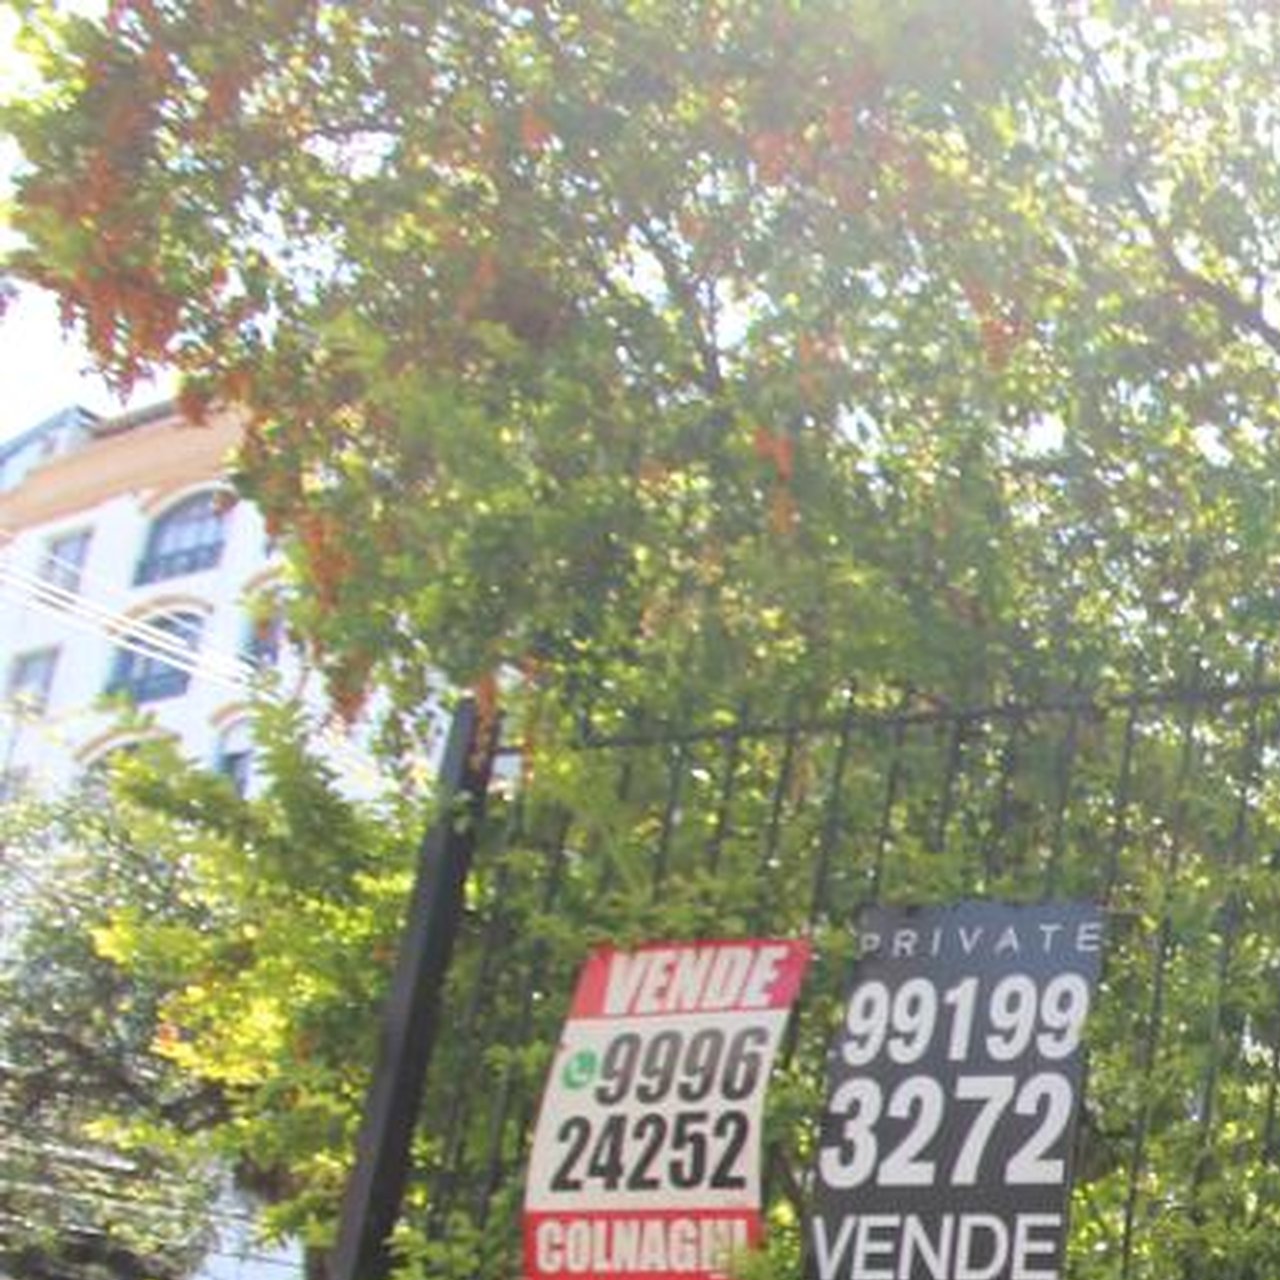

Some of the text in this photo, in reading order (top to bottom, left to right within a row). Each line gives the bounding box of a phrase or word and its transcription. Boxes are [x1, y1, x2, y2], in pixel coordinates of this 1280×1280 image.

[861, 922, 1104, 956] PRIVATE
[603, 944, 790, 1017] VENDE
[841, 972, 1090, 1067] 99199
[595, 1026, 769, 1105] 9996
[550, 1110, 750, 1193] 24252
[818, 1071, 1073, 1189] 3272
